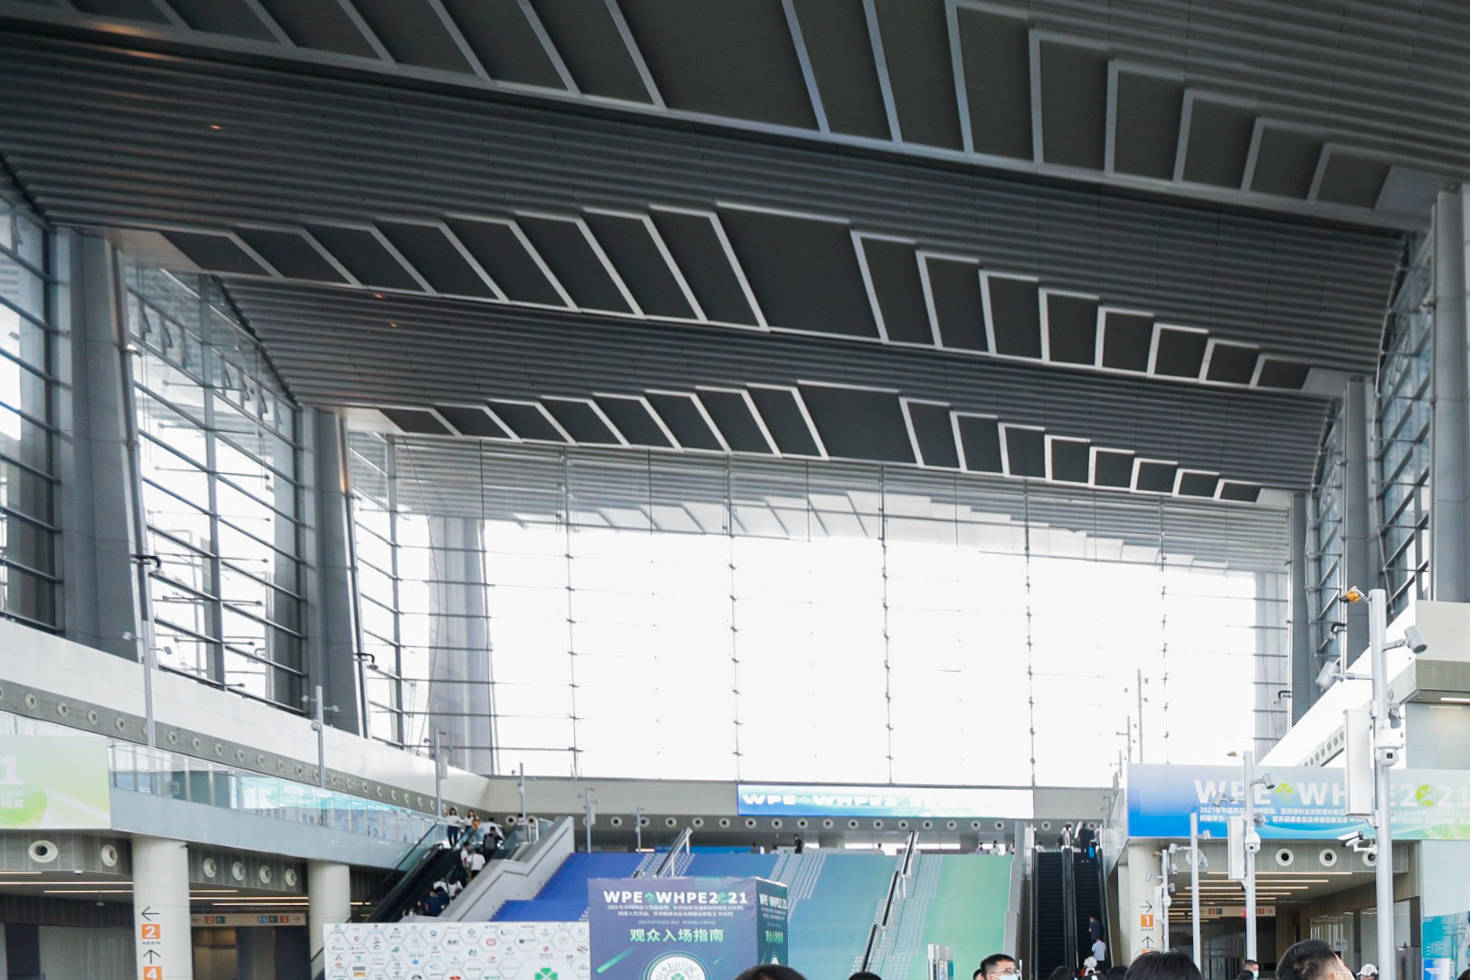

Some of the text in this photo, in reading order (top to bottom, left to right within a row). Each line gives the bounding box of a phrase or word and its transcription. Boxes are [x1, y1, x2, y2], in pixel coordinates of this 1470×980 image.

[603, 891, 643, 904] WPE
[629, 927, 725, 943] 观众入场指南
